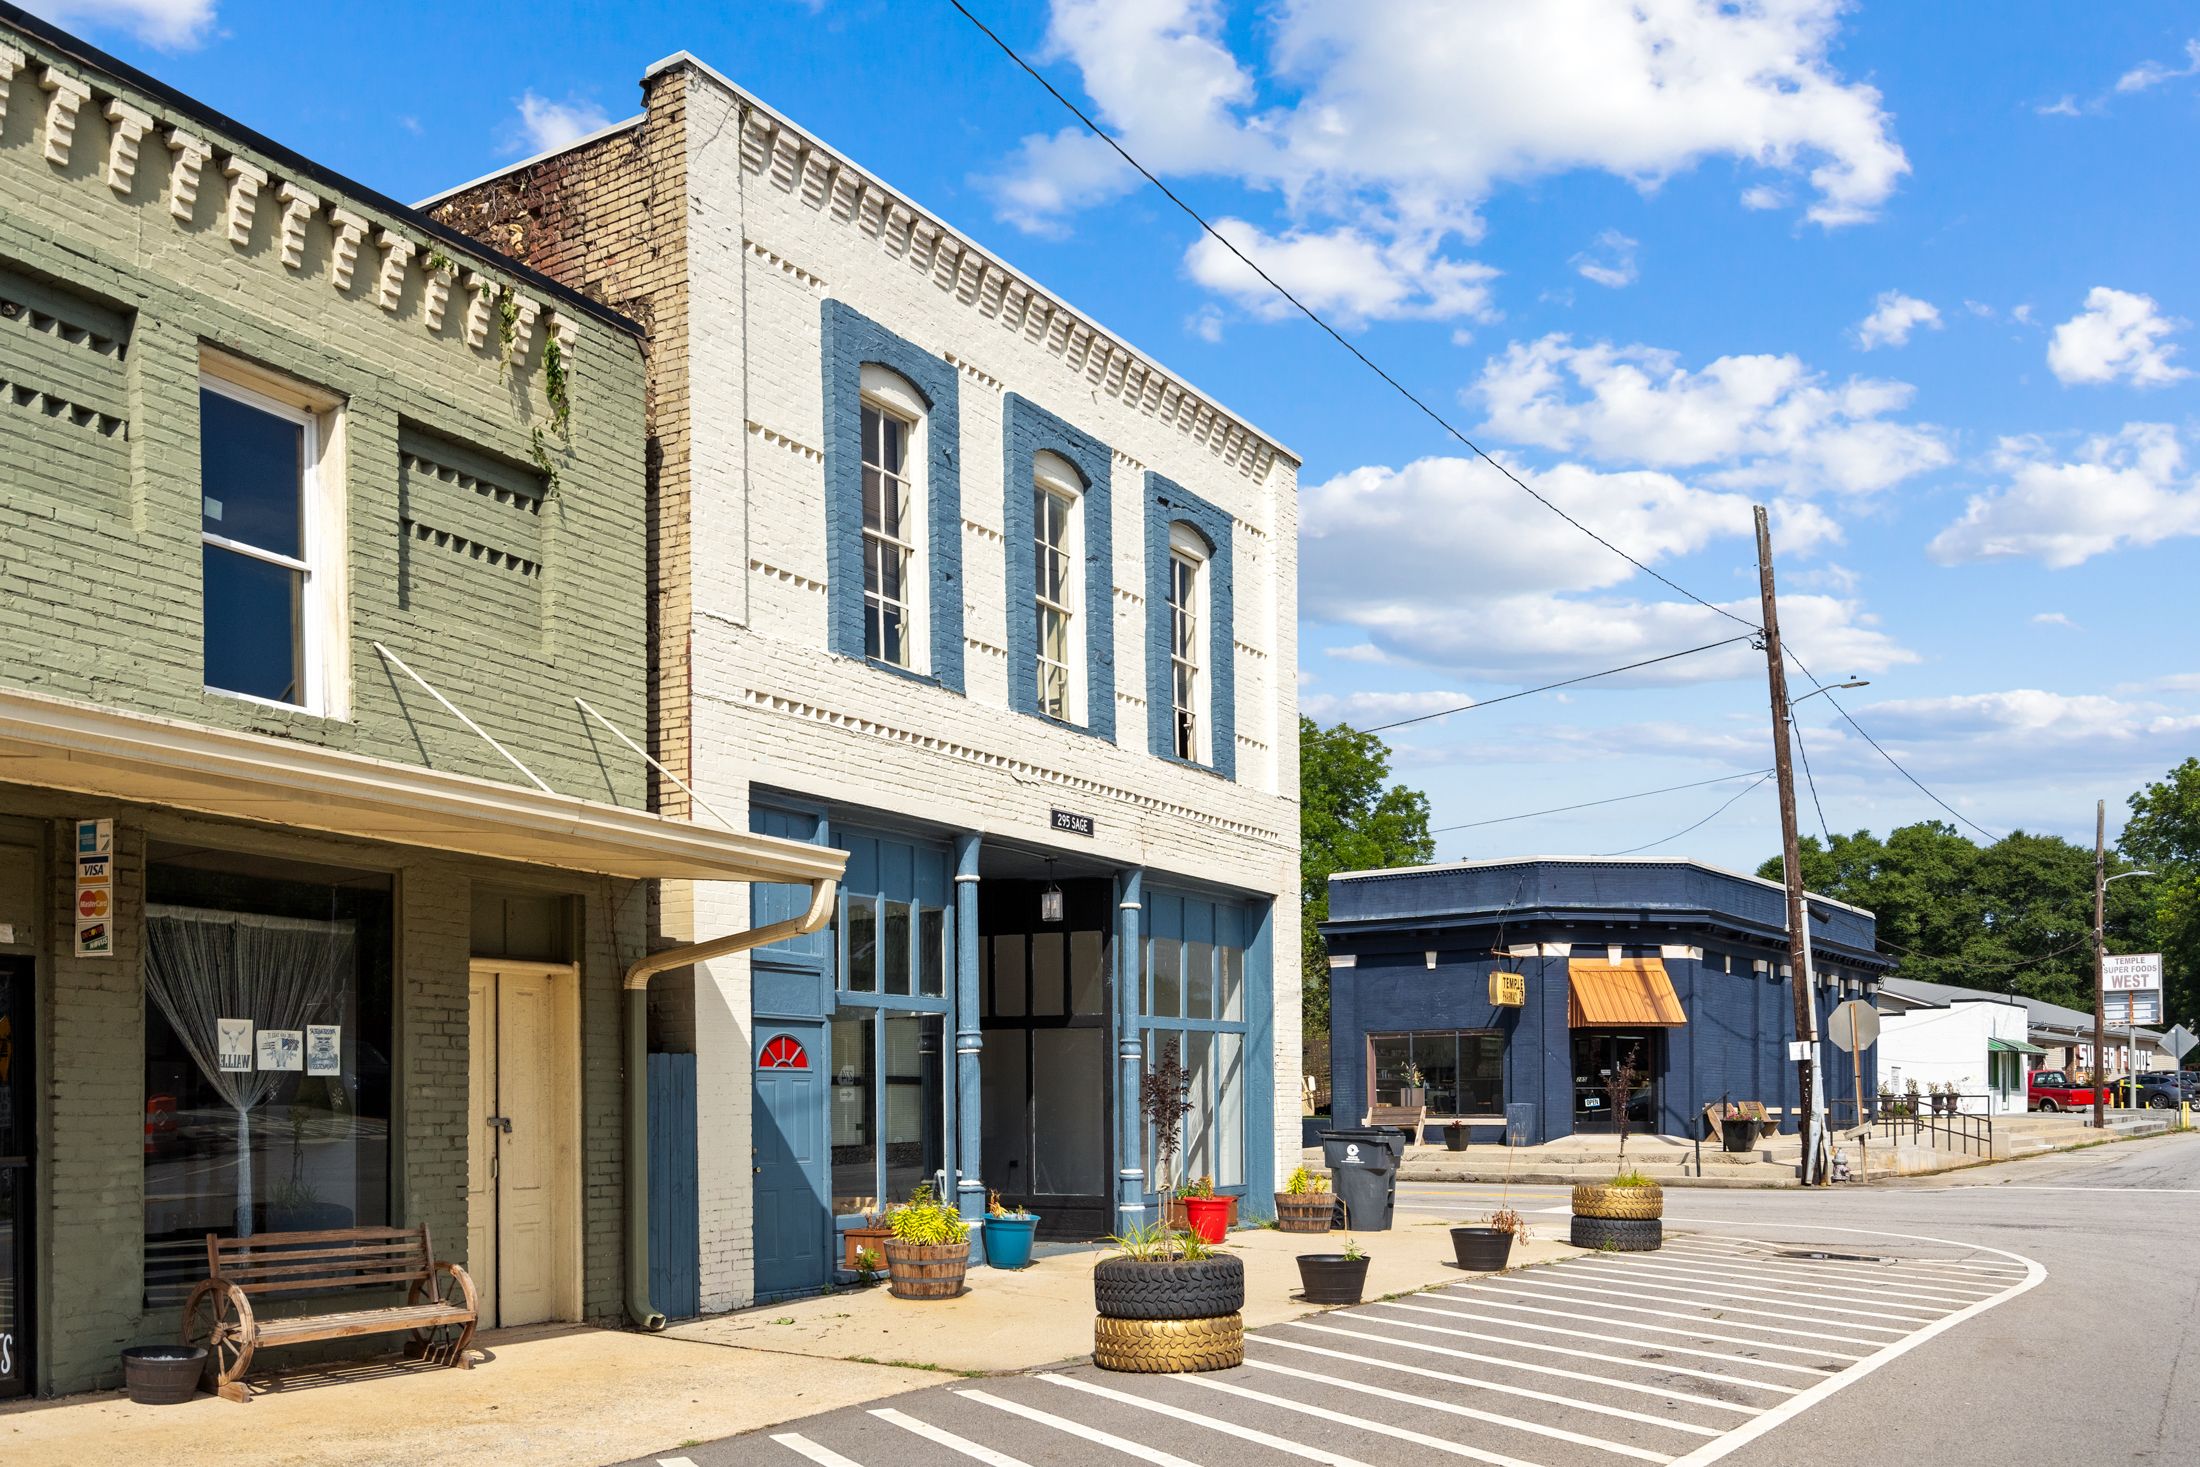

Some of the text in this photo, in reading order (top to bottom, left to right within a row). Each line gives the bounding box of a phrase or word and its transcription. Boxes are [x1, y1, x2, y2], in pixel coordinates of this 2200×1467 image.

[1057, 813, 1088, 832] 295 SAGE
[84, 864, 104, 876] VISA
[80, 900, 108, 908] MasterCard
[90, 937, 108, 950] NOVUS
[2115, 957, 2145, 965] TEMPLE
[2104, 965, 2158, 974] SUPER FOODS
[1503, 977, 1523, 990] TEMPLE
[2111, 974, 2149, 988] WEST
[2078, 1044, 2153, 1071] SUER FODS
